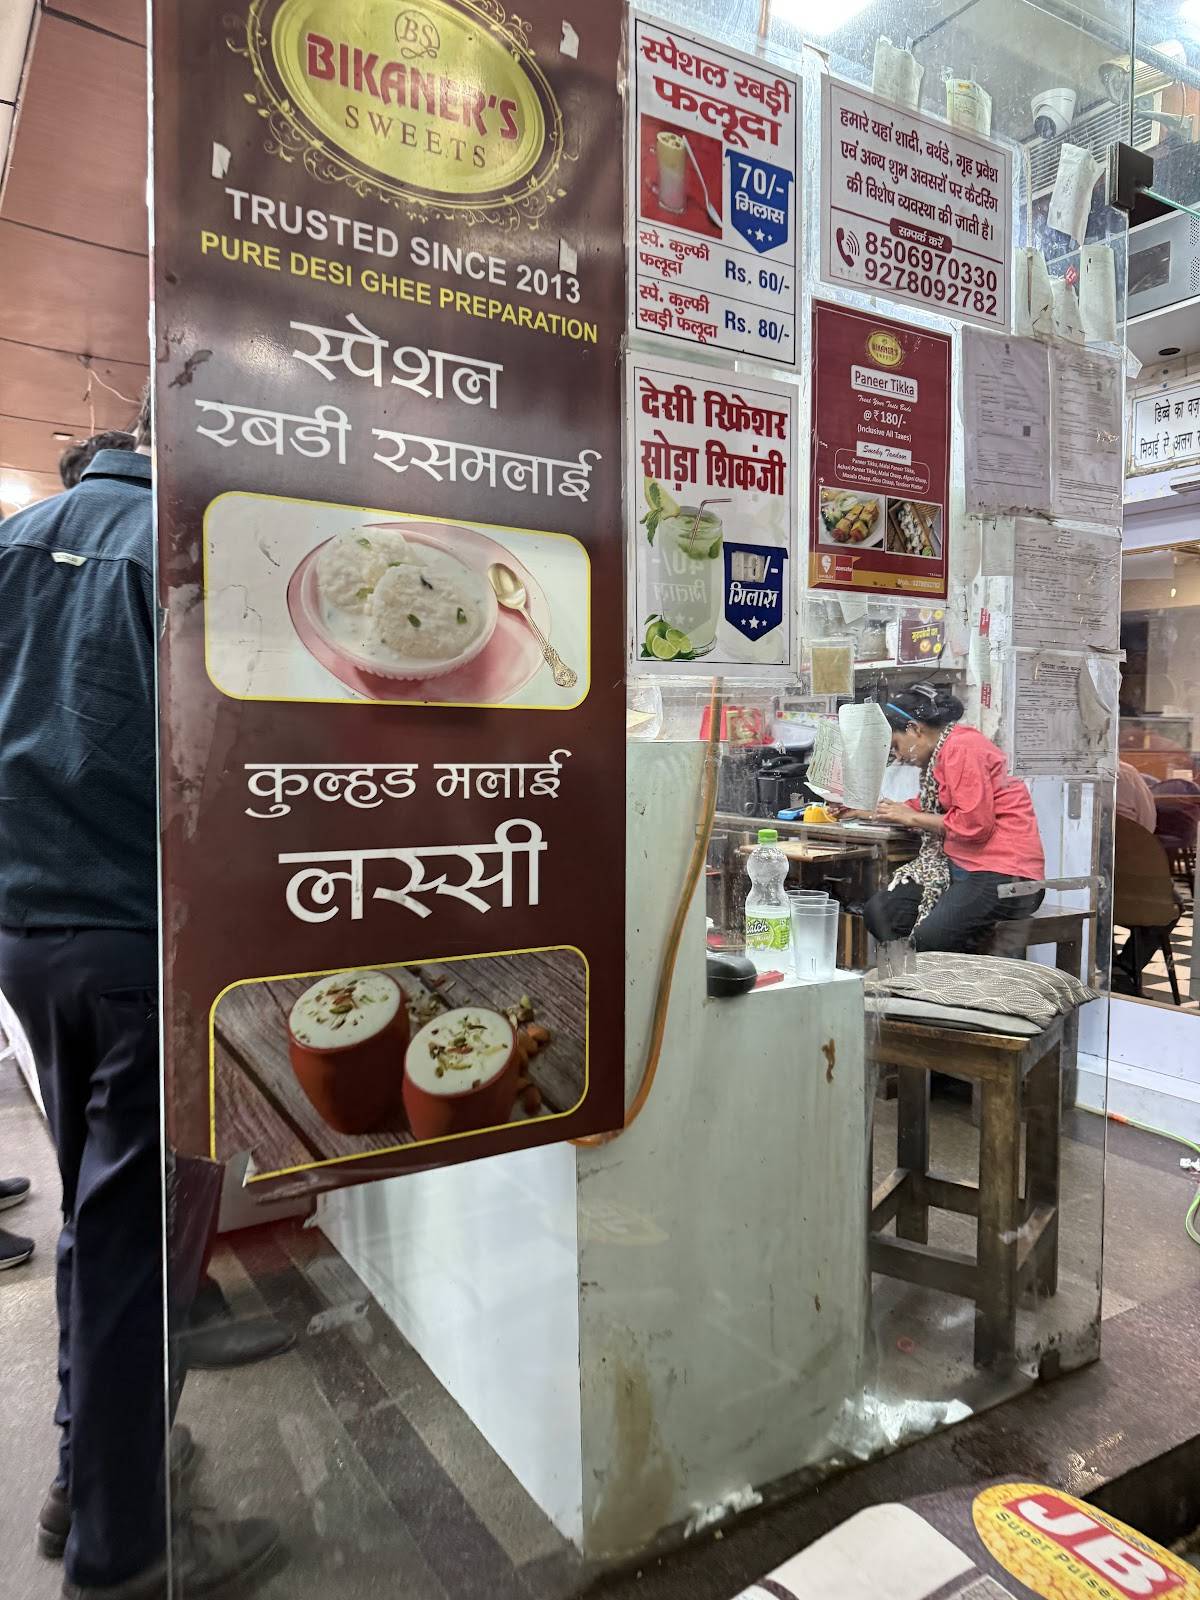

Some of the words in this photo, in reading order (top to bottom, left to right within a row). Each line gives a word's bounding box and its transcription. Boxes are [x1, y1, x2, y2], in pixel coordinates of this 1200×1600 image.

[307, 34, 518, 140] BIKANER'S
[641, 36, 729, 89] स्पेशल
[733, 79, 791, 116] रबड़ी
[346, 105, 487, 168] SWEETS
[653, 75, 782, 148] फलूदा
[840, 107, 869, 133] हमारे
[871, 120, 893, 142] यहां
[895, 129, 922, 155] शादी,
[956, 153, 973, 177] गृह
[976, 160, 998, 183] प्रवेश
[840, 140, 859, 160] एवं
[860, 148, 886, 171] अन्य
[889, 159, 908, 184] शुभ
[911, 167, 948, 193] अवसरों
[949, 181, 963, 199] पर
[735, 192, 784, 225] गिलास
[738, 162, 784, 199] 70/-
[846, 171, 863, 195] की
[866, 176, 895, 206] विशेष
[898, 193, 936, 220] व्यवस्था
[938, 204, 952, 226] की
[955, 213, 979, 236] जाती
[225, 187, 399, 258] TRUSTED
[410, 236, 506, 286] SINCE
[516, 265, 581, 304] 2013
[640, 230, 664, 248] स्पे.
[669, 238, 710, 261] कुल्फी
[640, 251, 683, 278] फलूदा
[865, 231, 997, 292] 8506970330
[898, 225, 927, 243] सम्पर्क
[928, 237, 944, 249] करें
[201, 230, 281, 271] PURE
[291, 252, 352, 287] DESI
[361, 269, 431, 305] GHEE
[440, 287, 598, 343] PREPARATION
[640, 282, 664, 302] स्पे.
[669, 291, 710, 314] कुल्फी
[725, 259, 751, 285] Rs.
[759, 269, 790, 295] 60/-
[864, 257, 997, 317] 9278092782
[640, 306, 673, 331] रबड़ी
[677, 316, 718, 344] फलूदा
[725, 309, 751, 334] Rs.
[758, 319, 790, 343] 80/-
[290, 312, 503, 409] स्पेशल
[855, 370, 888, 390] Paneer
[890, 378, 914, 395] Tikka
[640, 376, 697, 426] देसी
[704, 389, 788, 440] रिफ्रेशर
[886, 428, 894, 438] All
[1154, 399, 1170, 425] डिब्बे
[1174, 402, 1184, 418] का
[372, 428, 602, 502] रसमलाई
[640, 430, 699, 492] सोड़ा
[705, 439, 786, 496] शिकंजी
[1140, 432, 1159, 459] मिठाई
[1174, 432, 1193, 451] अलग
[728, 582, 779, 609] गिलास
[244, 763, 418, 818] कुल्हड
[433, 749, 572, 799] मलाई
[279, 818, 547, 923] लस्सी
[995, 1511, 1053, 1553] Super
[1053, 1553, 1119, 1600] Pulse
[1017, 1499, 1169, 1596] JB
